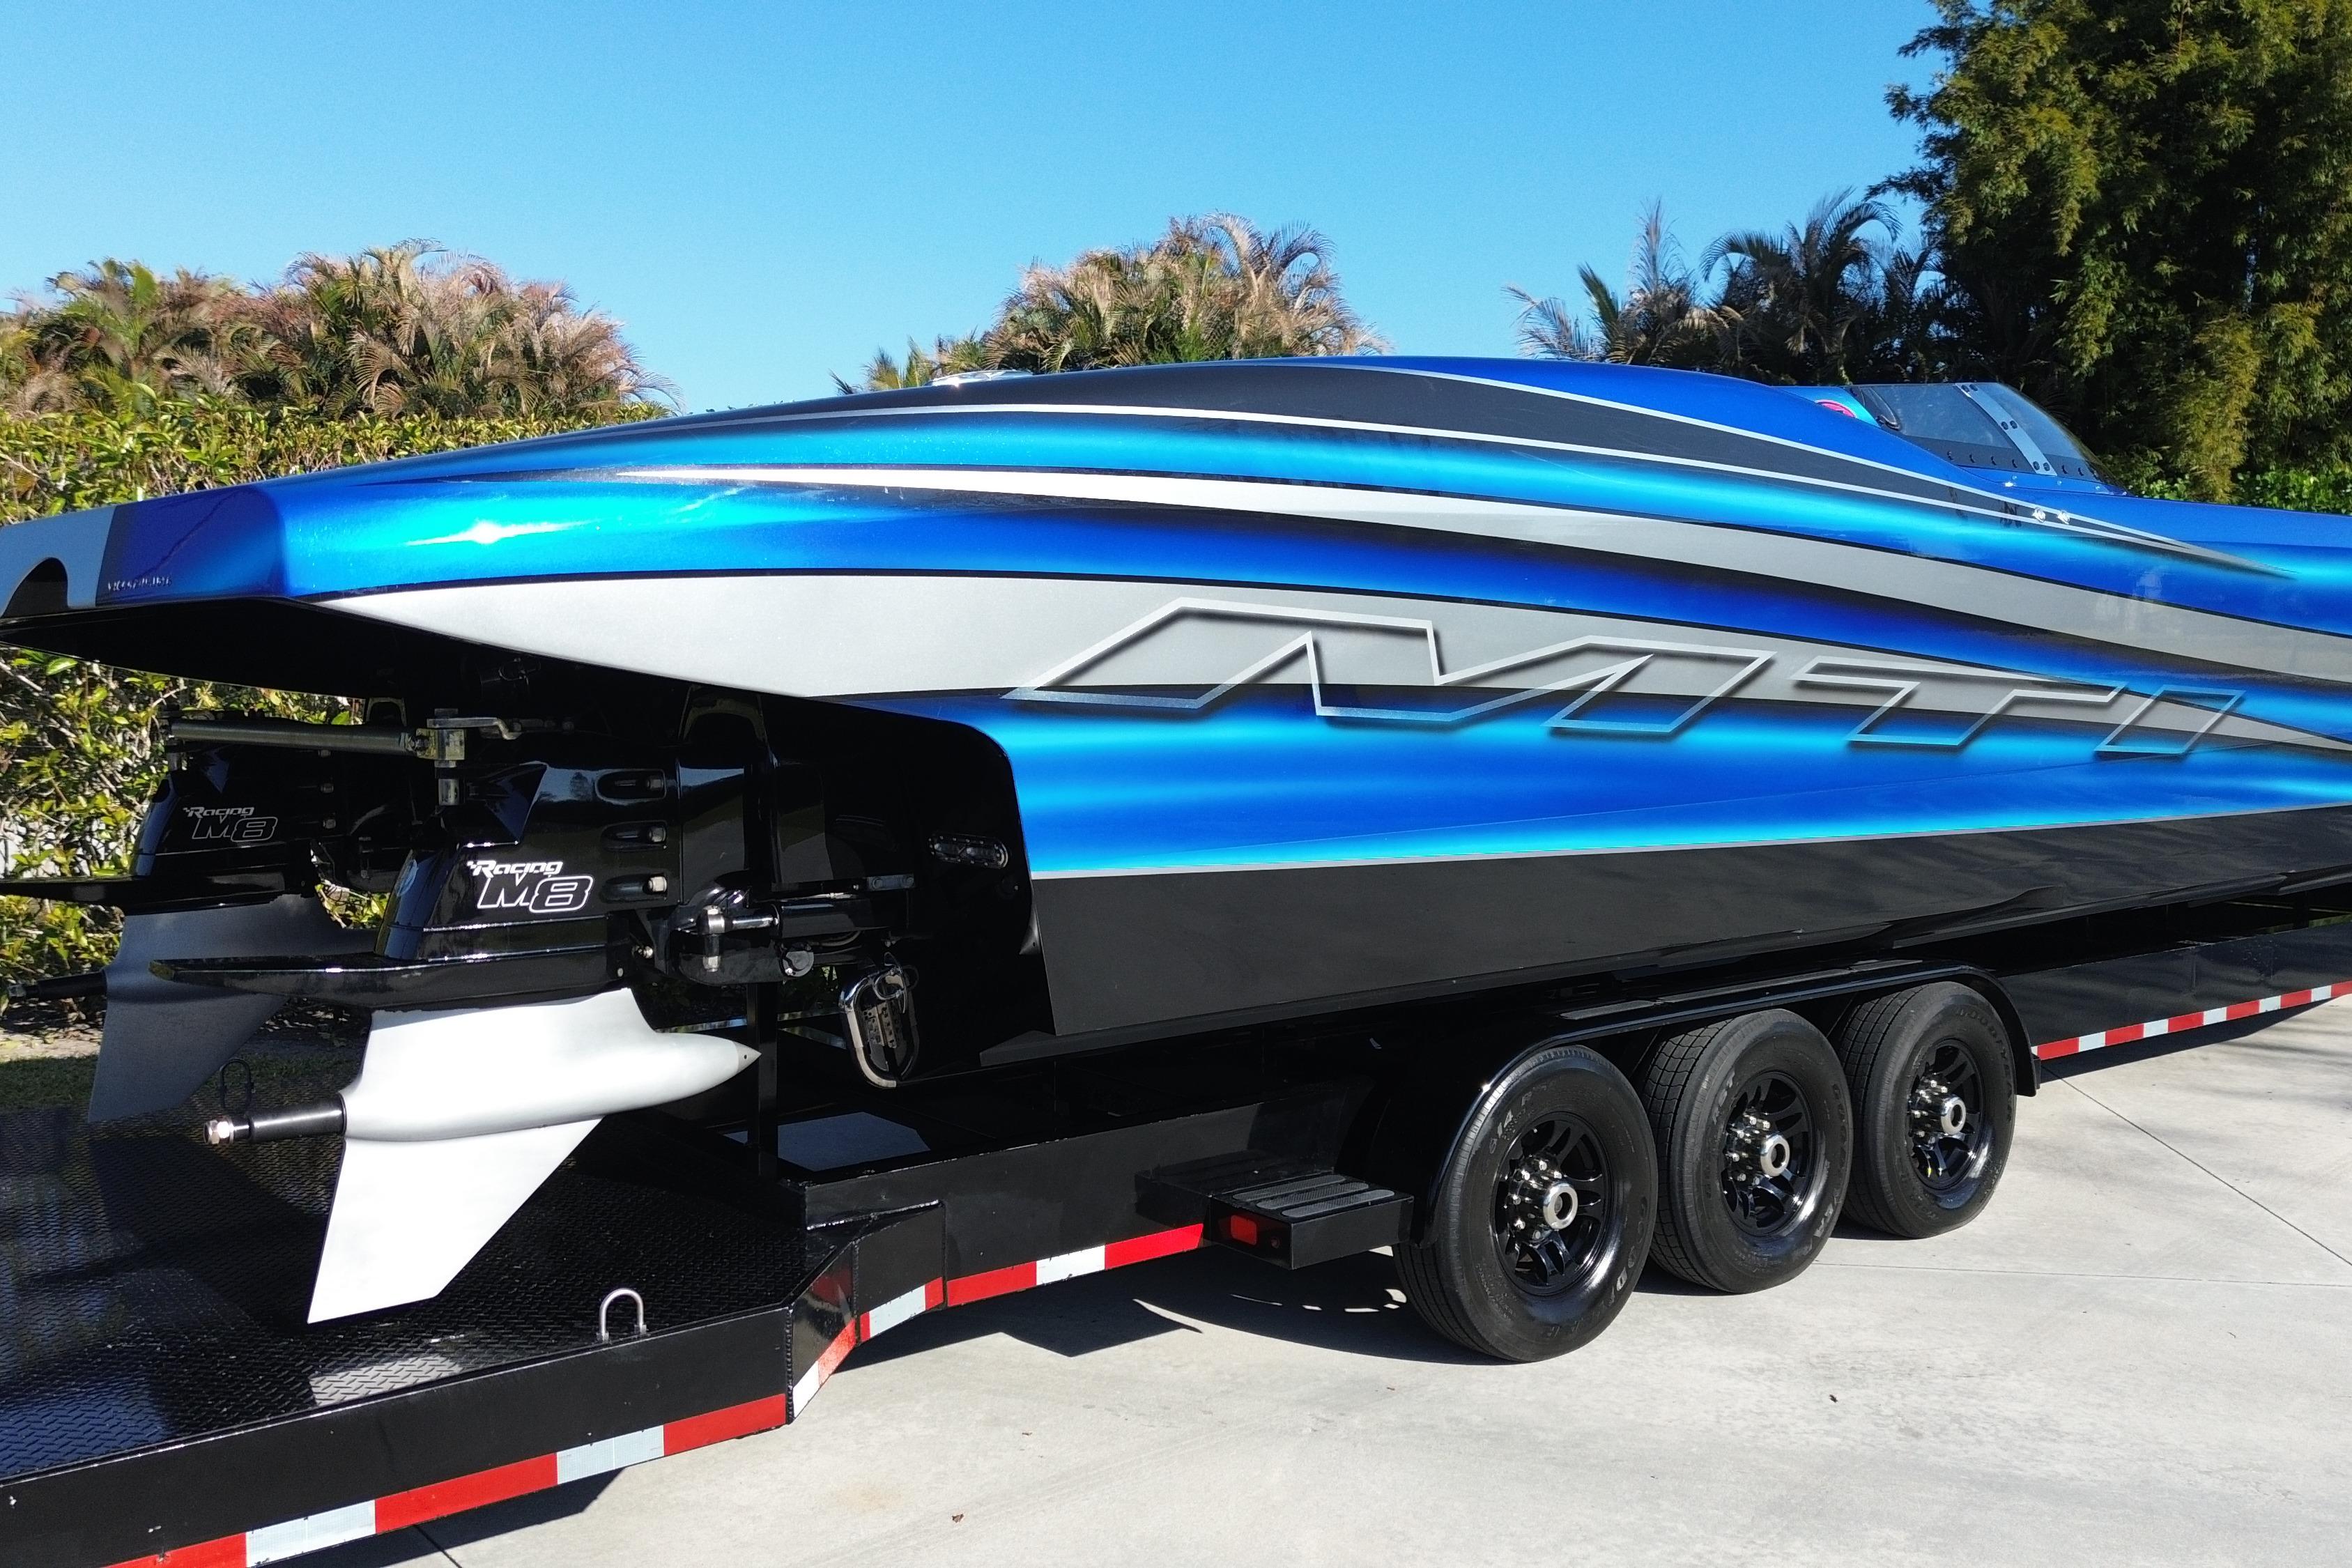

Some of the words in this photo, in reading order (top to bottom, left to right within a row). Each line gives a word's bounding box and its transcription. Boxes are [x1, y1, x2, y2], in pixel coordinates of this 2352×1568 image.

[187, 806, 254, 819] Racing
[192, 813, 278, 843] M8
[472, 859, 563, 878] Racing
[477, 873, 594, 914] M8
